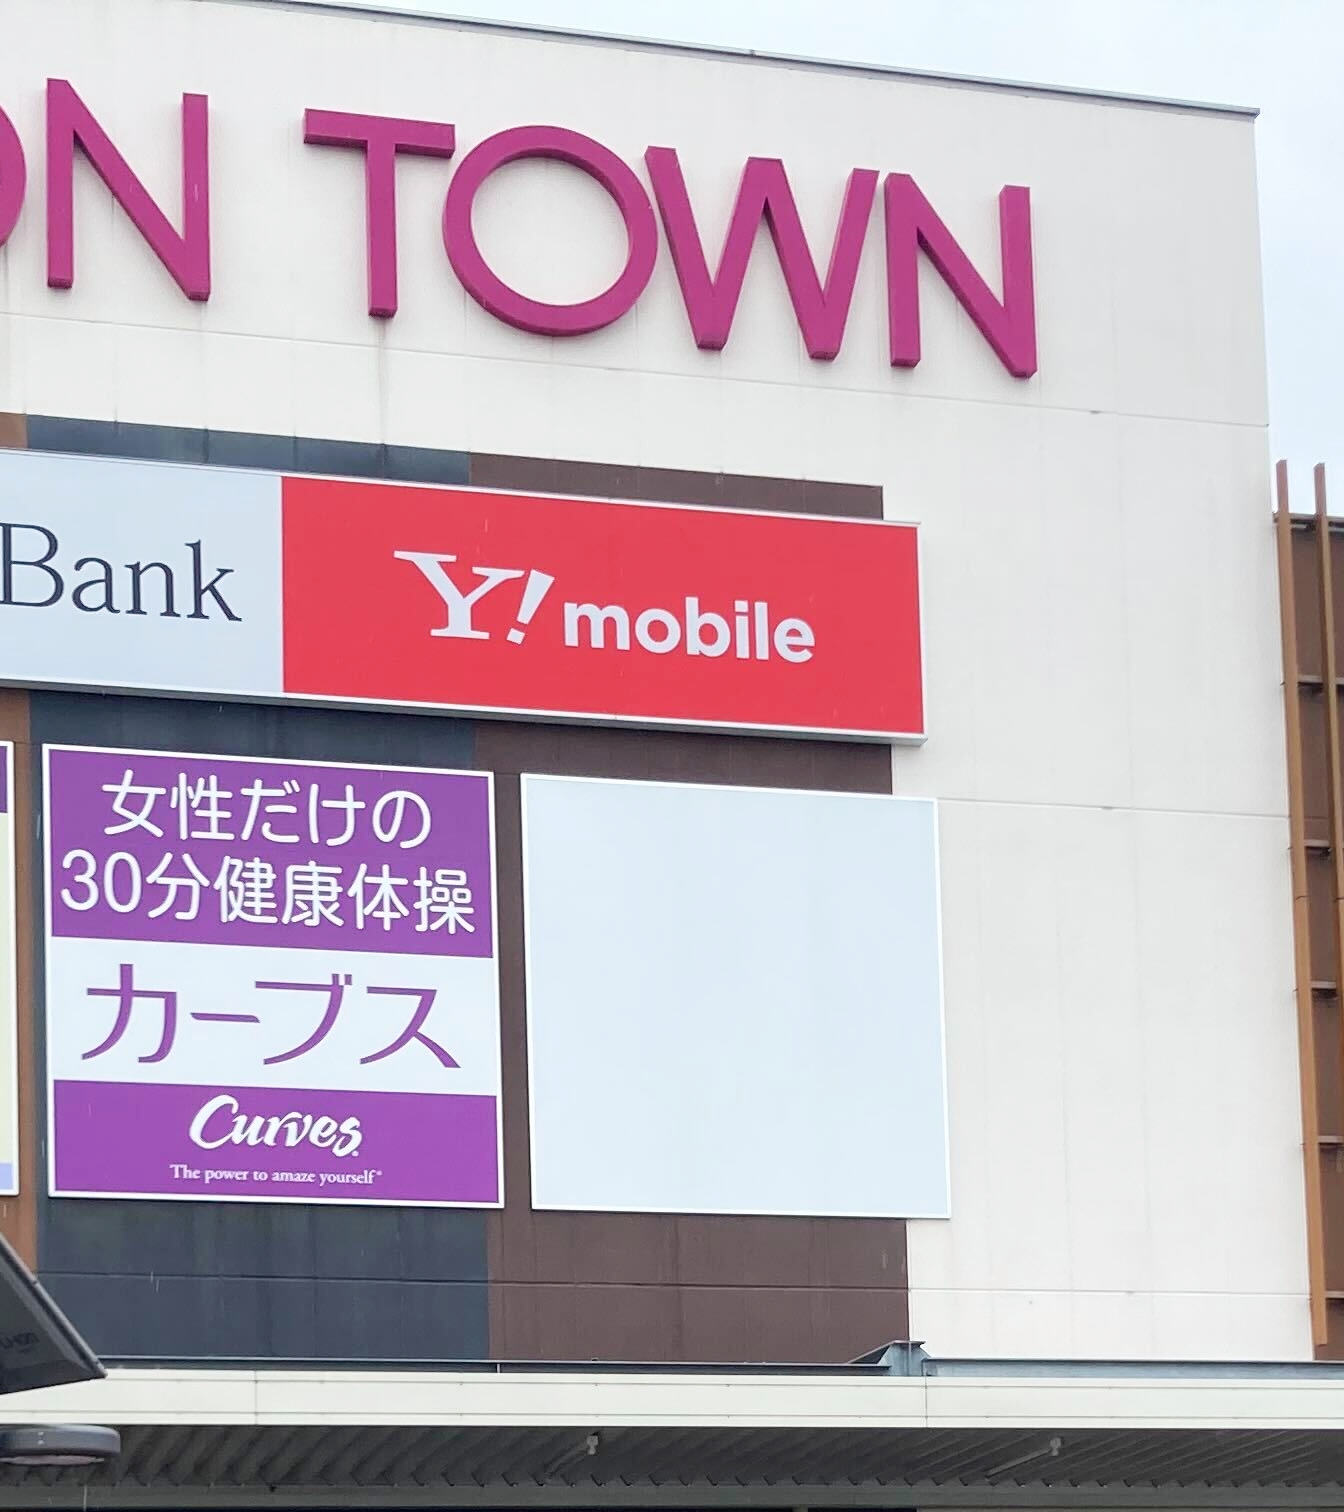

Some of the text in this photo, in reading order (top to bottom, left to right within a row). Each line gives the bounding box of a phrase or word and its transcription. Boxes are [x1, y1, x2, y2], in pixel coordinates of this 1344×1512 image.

[302, 108, 1039, 380] TOWN
[100, 769, 433, 849] 女性だけの
[60, 848, 476, 936] 30分健康体操
[81, 963, 462, 1069] カーブス
[188, 1094, 363, 1157] Curves
[170, 1164, 201, 1181] The
[203, 1167, 249, 1184] power
[252, 1169, 268, 1181] to
[271, 1169, 316, 1183] amaze
